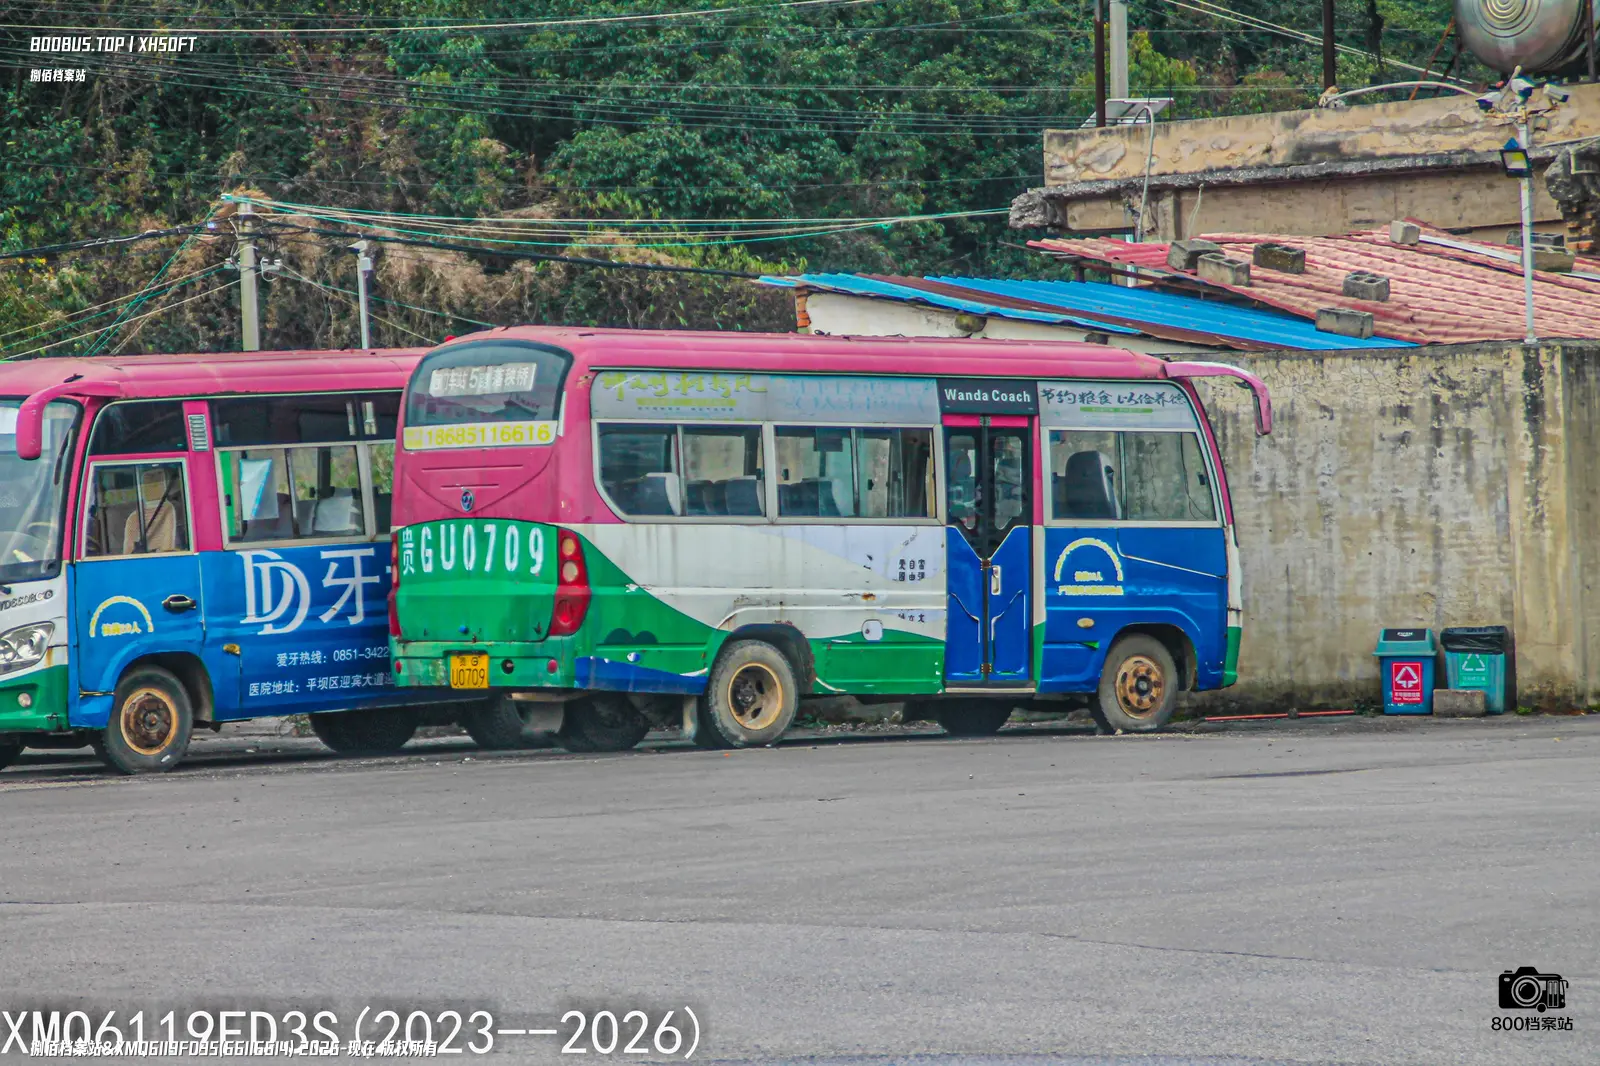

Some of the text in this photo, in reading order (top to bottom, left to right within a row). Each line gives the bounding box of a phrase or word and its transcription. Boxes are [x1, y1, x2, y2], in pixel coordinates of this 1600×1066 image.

[944, 388, 989, 402] Wanda
[991, 389, 1031, 403] Coach
[426, 423, 551, 446] 18685116616
[318, 547, 381, 626] 牙
[452, 668, 485, 686] U0709
